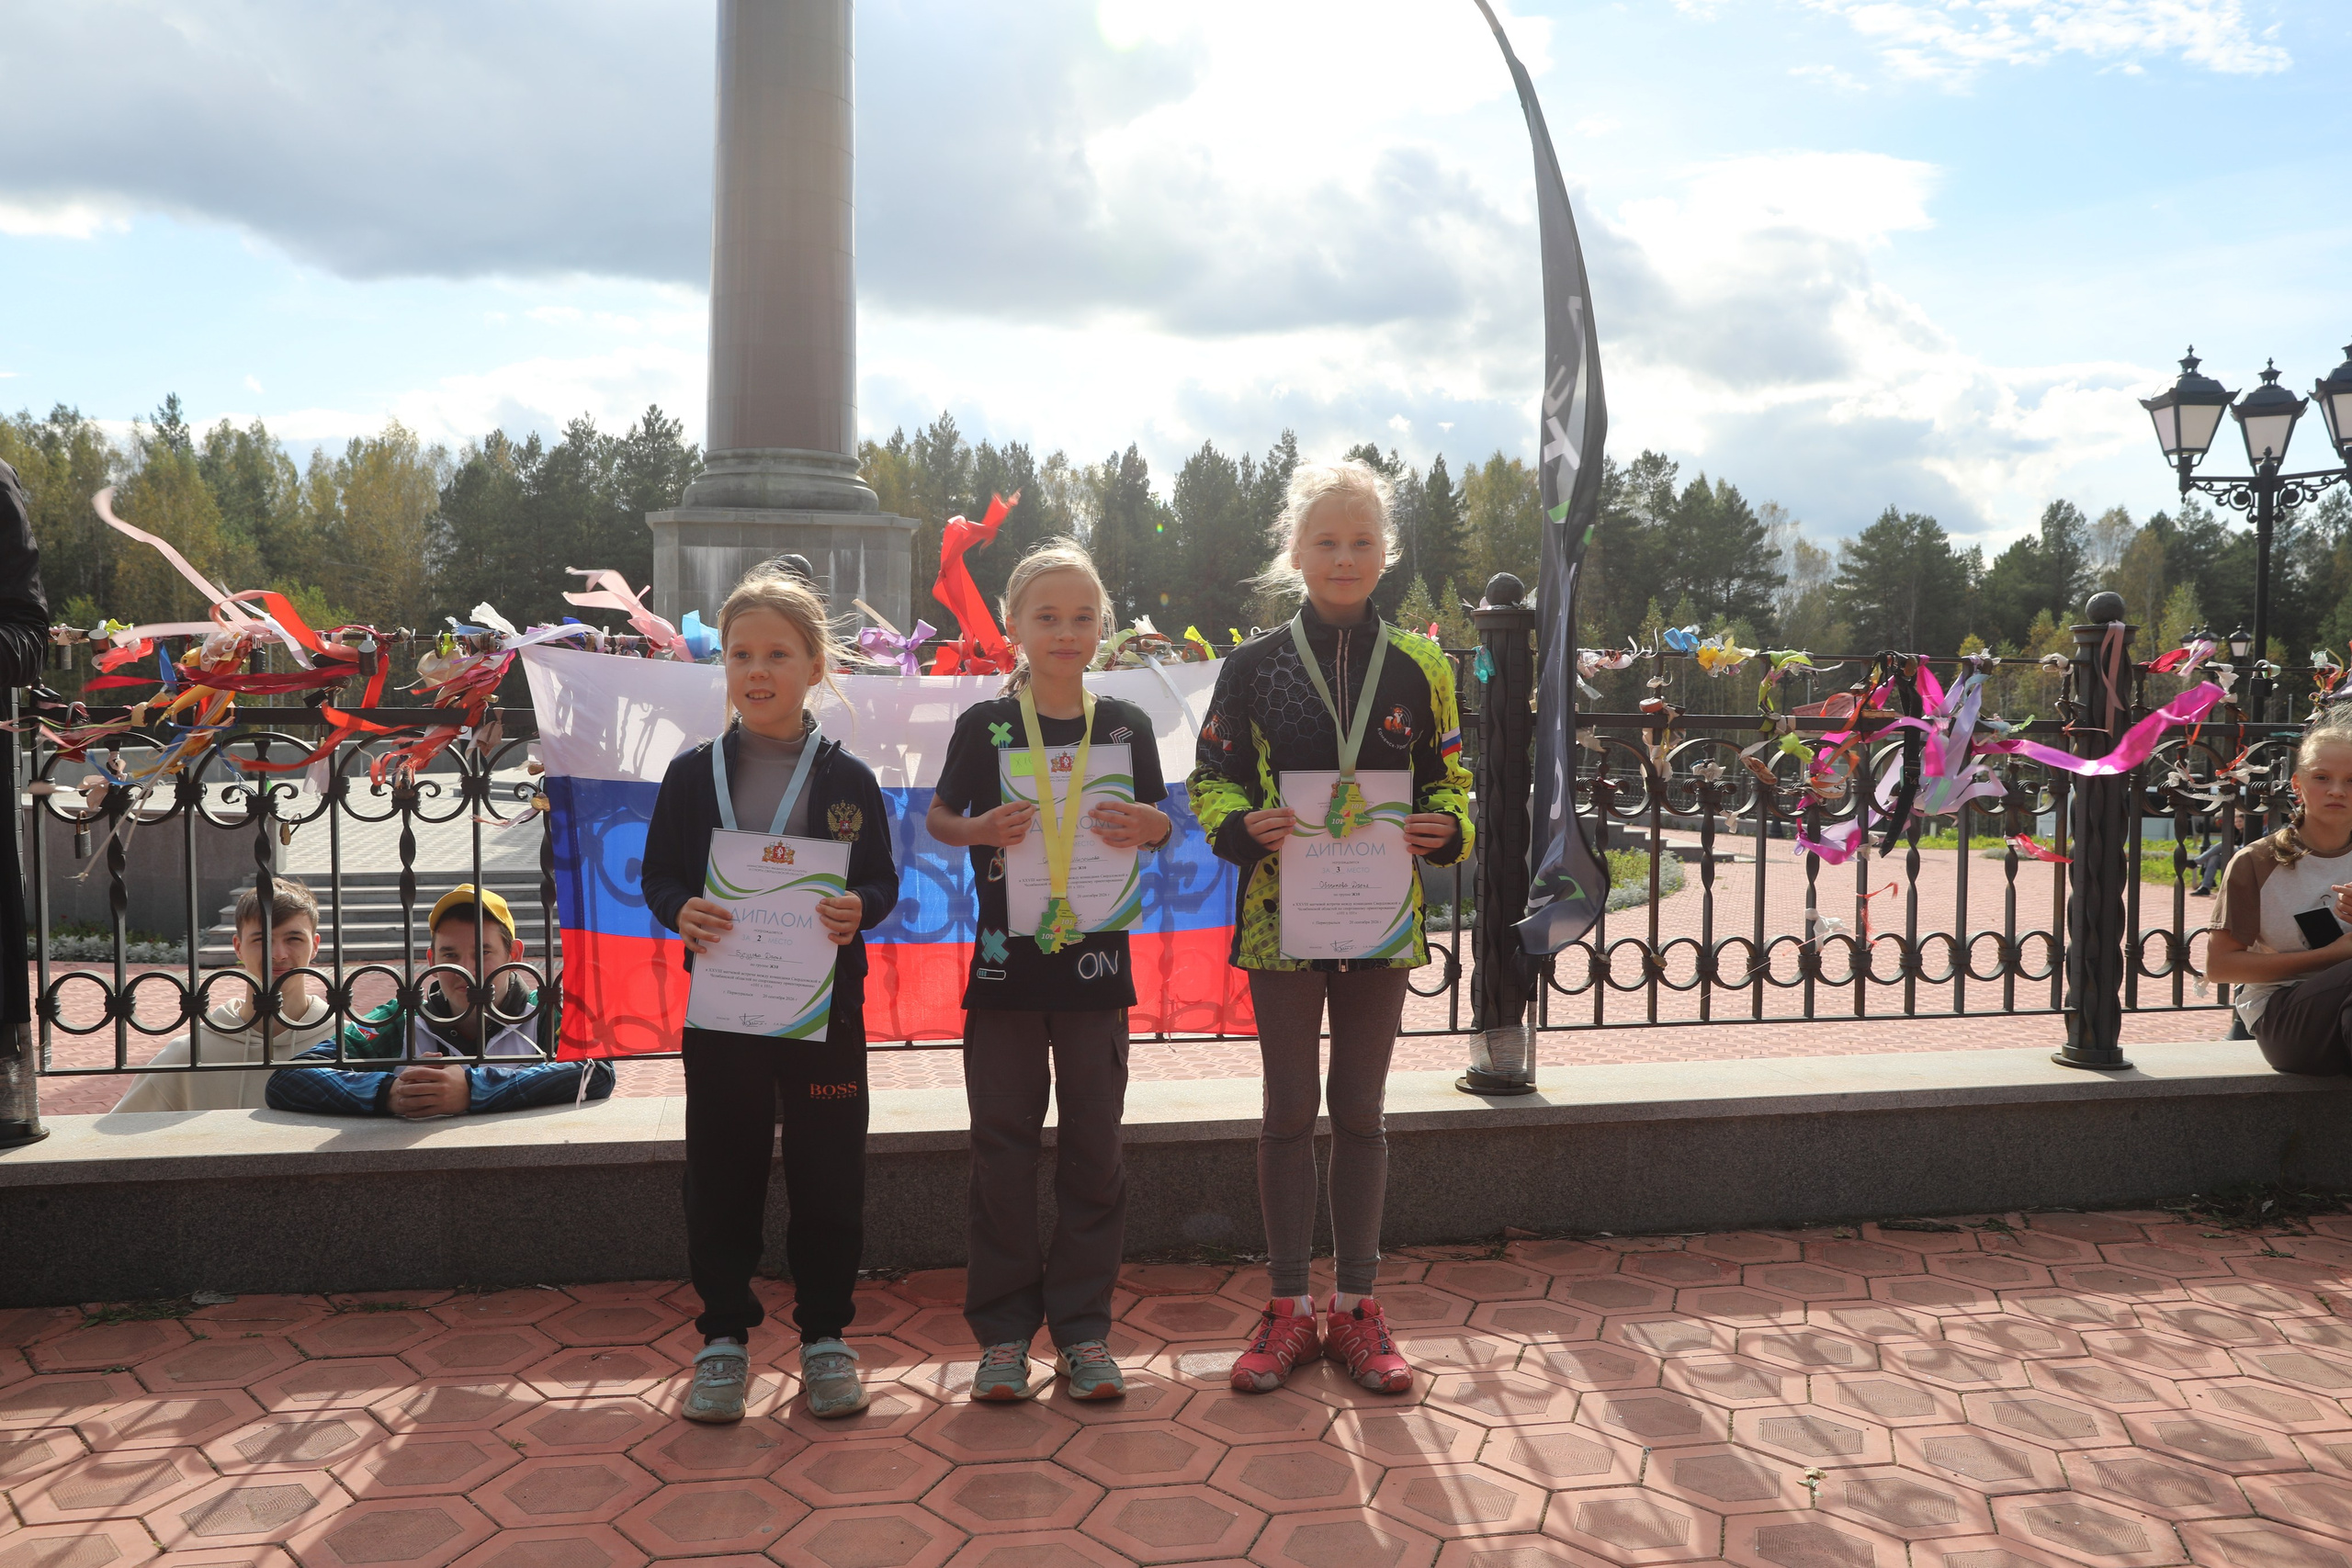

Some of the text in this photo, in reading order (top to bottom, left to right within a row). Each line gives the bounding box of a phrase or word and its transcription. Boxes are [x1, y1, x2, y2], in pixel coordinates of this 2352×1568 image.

[1305, 842, 1385, 858] ДИПЛОМ
[731, 907, 812, 930] ДИПЛОМ
[768, 938, 793, 946] МЕСТО
[1078, 950, 1118, 979] ON
[810, 1081, 857, 1095] BOSS
